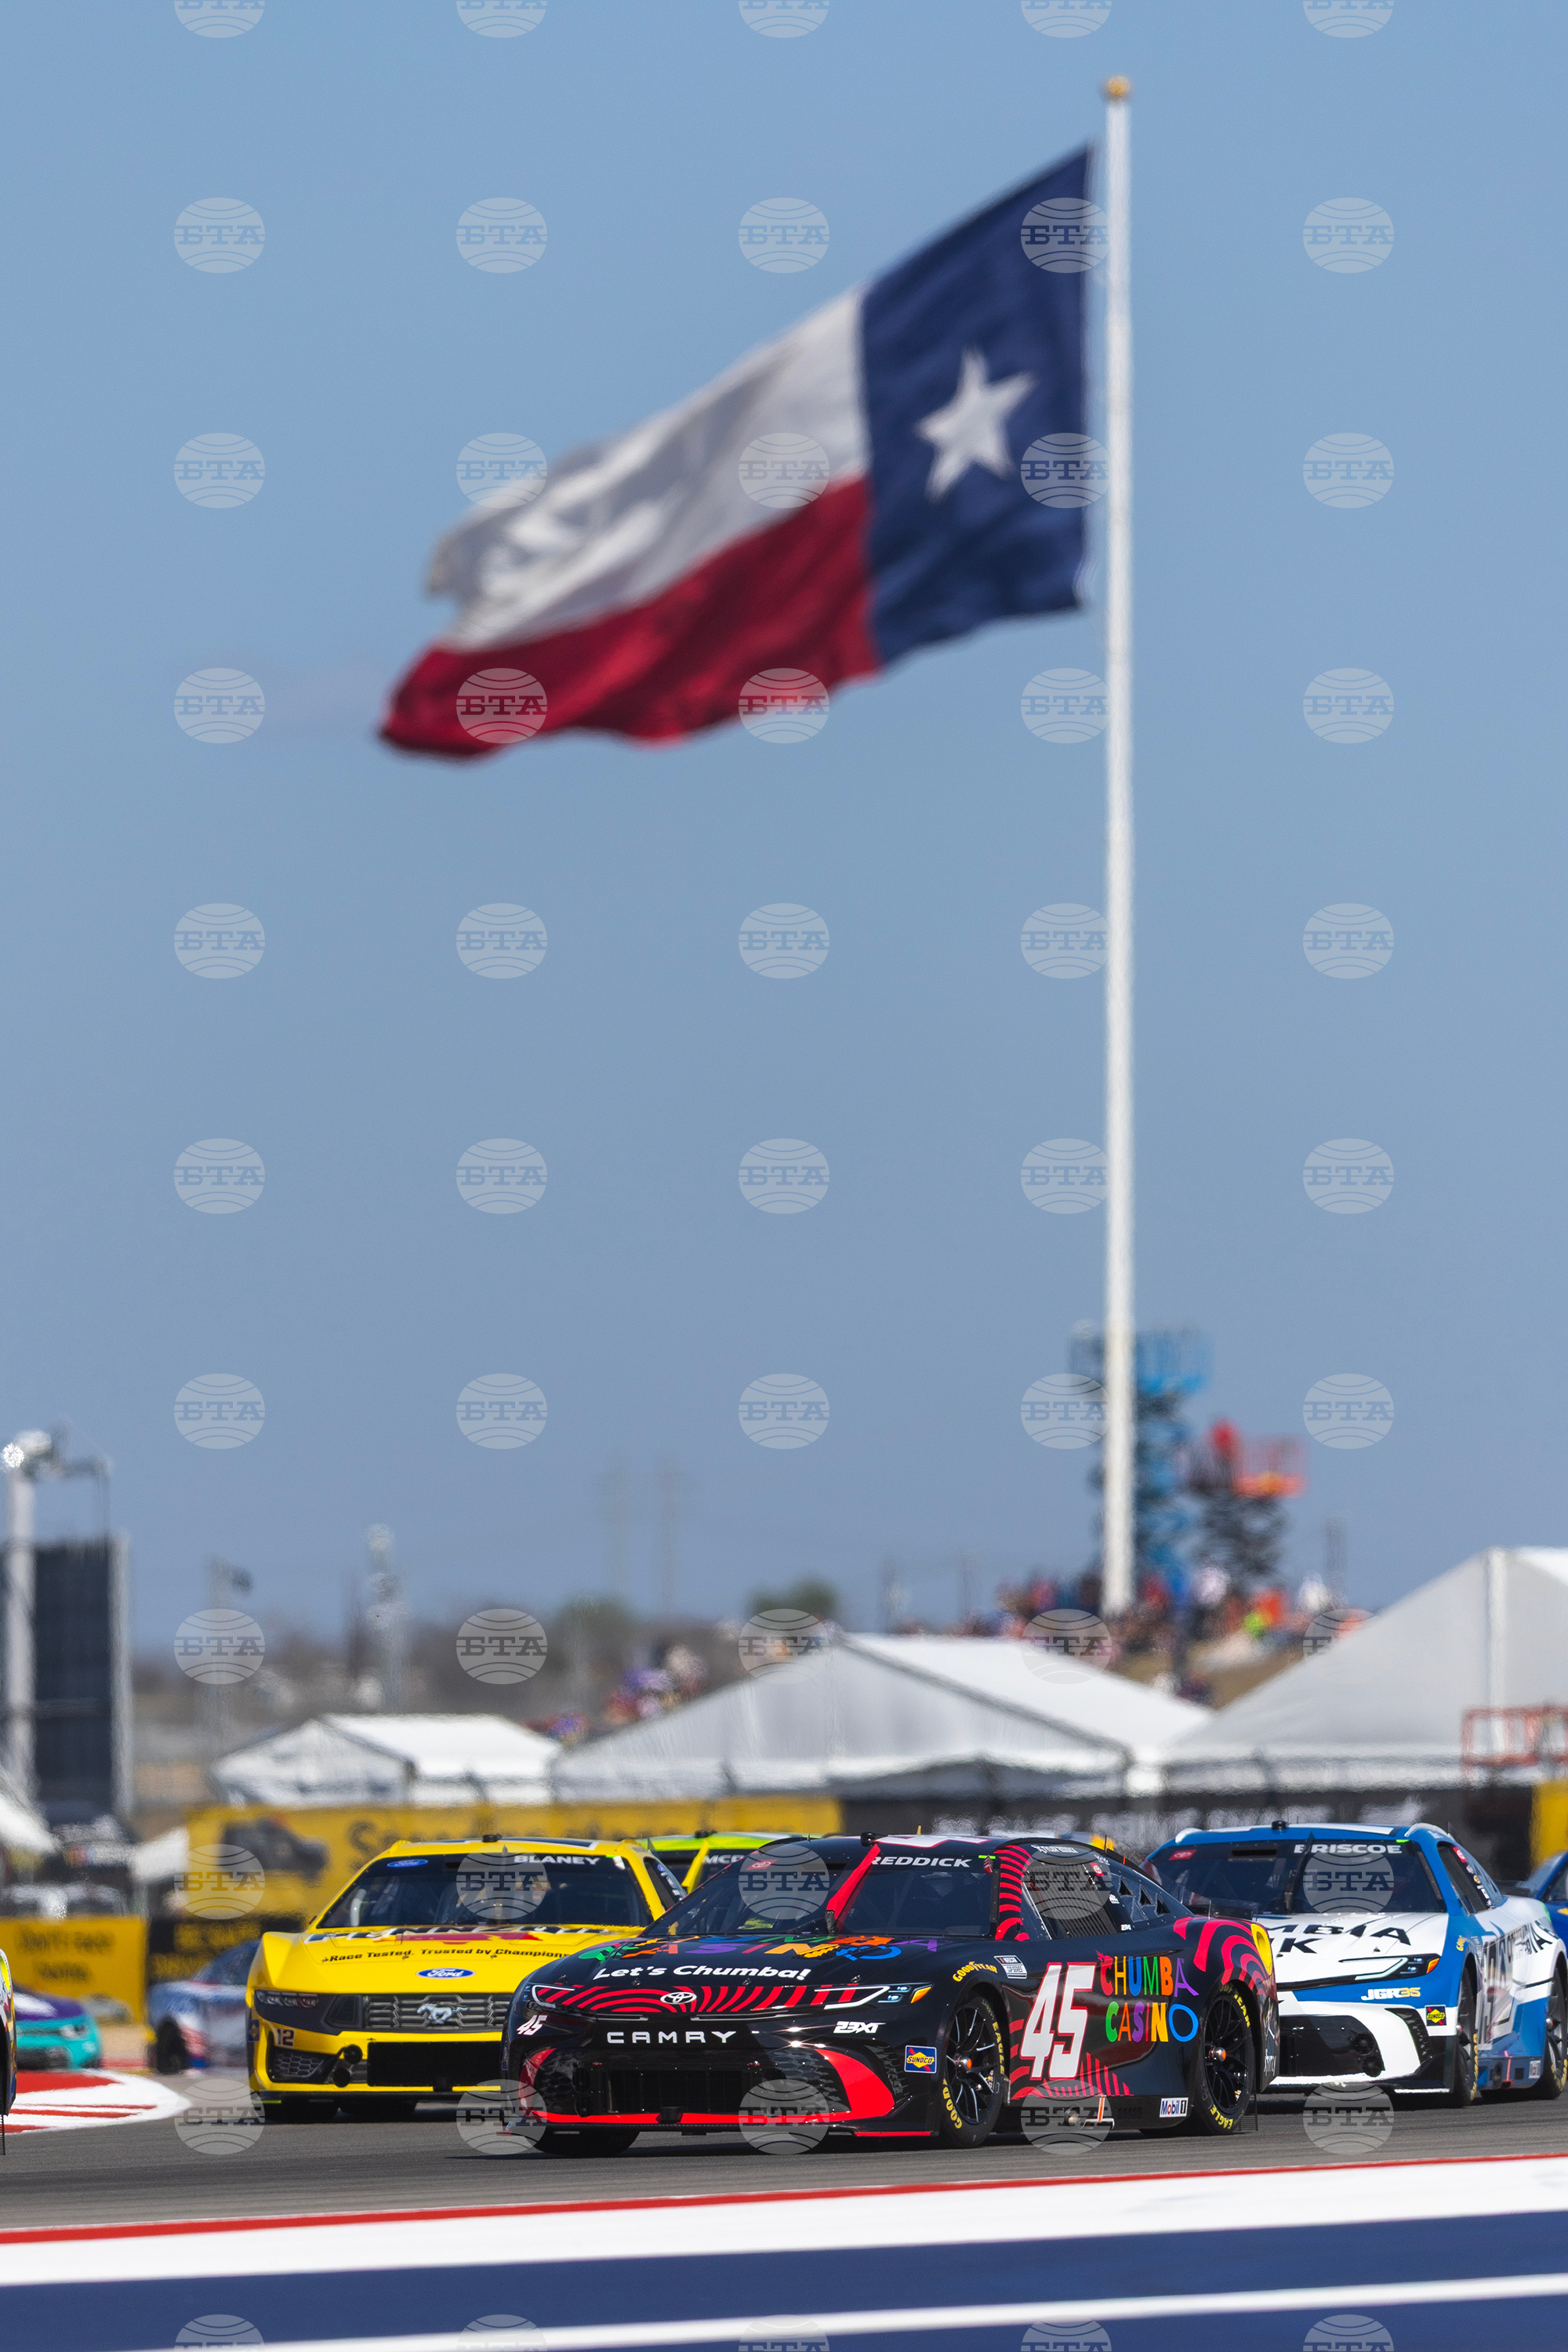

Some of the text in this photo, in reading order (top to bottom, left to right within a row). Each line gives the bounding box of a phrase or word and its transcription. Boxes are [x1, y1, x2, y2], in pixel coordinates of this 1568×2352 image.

[1294, 1843, 1403, 1854] BRISCOE
[514, 1855, 601, 1865] BLANEY
[871, 1856, 972, 1868] REDDICK
[1265, 1924, 1412, 1946] MBIA
[430, 1968, 464, 1979] Ford
[593, 1965, 811, 1980] Let's Chumba!
[952, 1961, 998, 1982] GOODYEAR
[1100, 1955, 1200, 1998] CHUMBA
[517, 2014, 548, 2036] 45
[1020, 1962, 1098, 2081] 45
[1105, 2001, 1200, 2042] CASINO
[276, 2028, 296, 2049] 12
[607, 2030, 737, 2044] CAMRY
[992, 2021, 1005, 2074] EAGLE
[1160, 2100, 1181, 2115] Mobil
[1210, 2104, 1234, 2130] EAGLE
